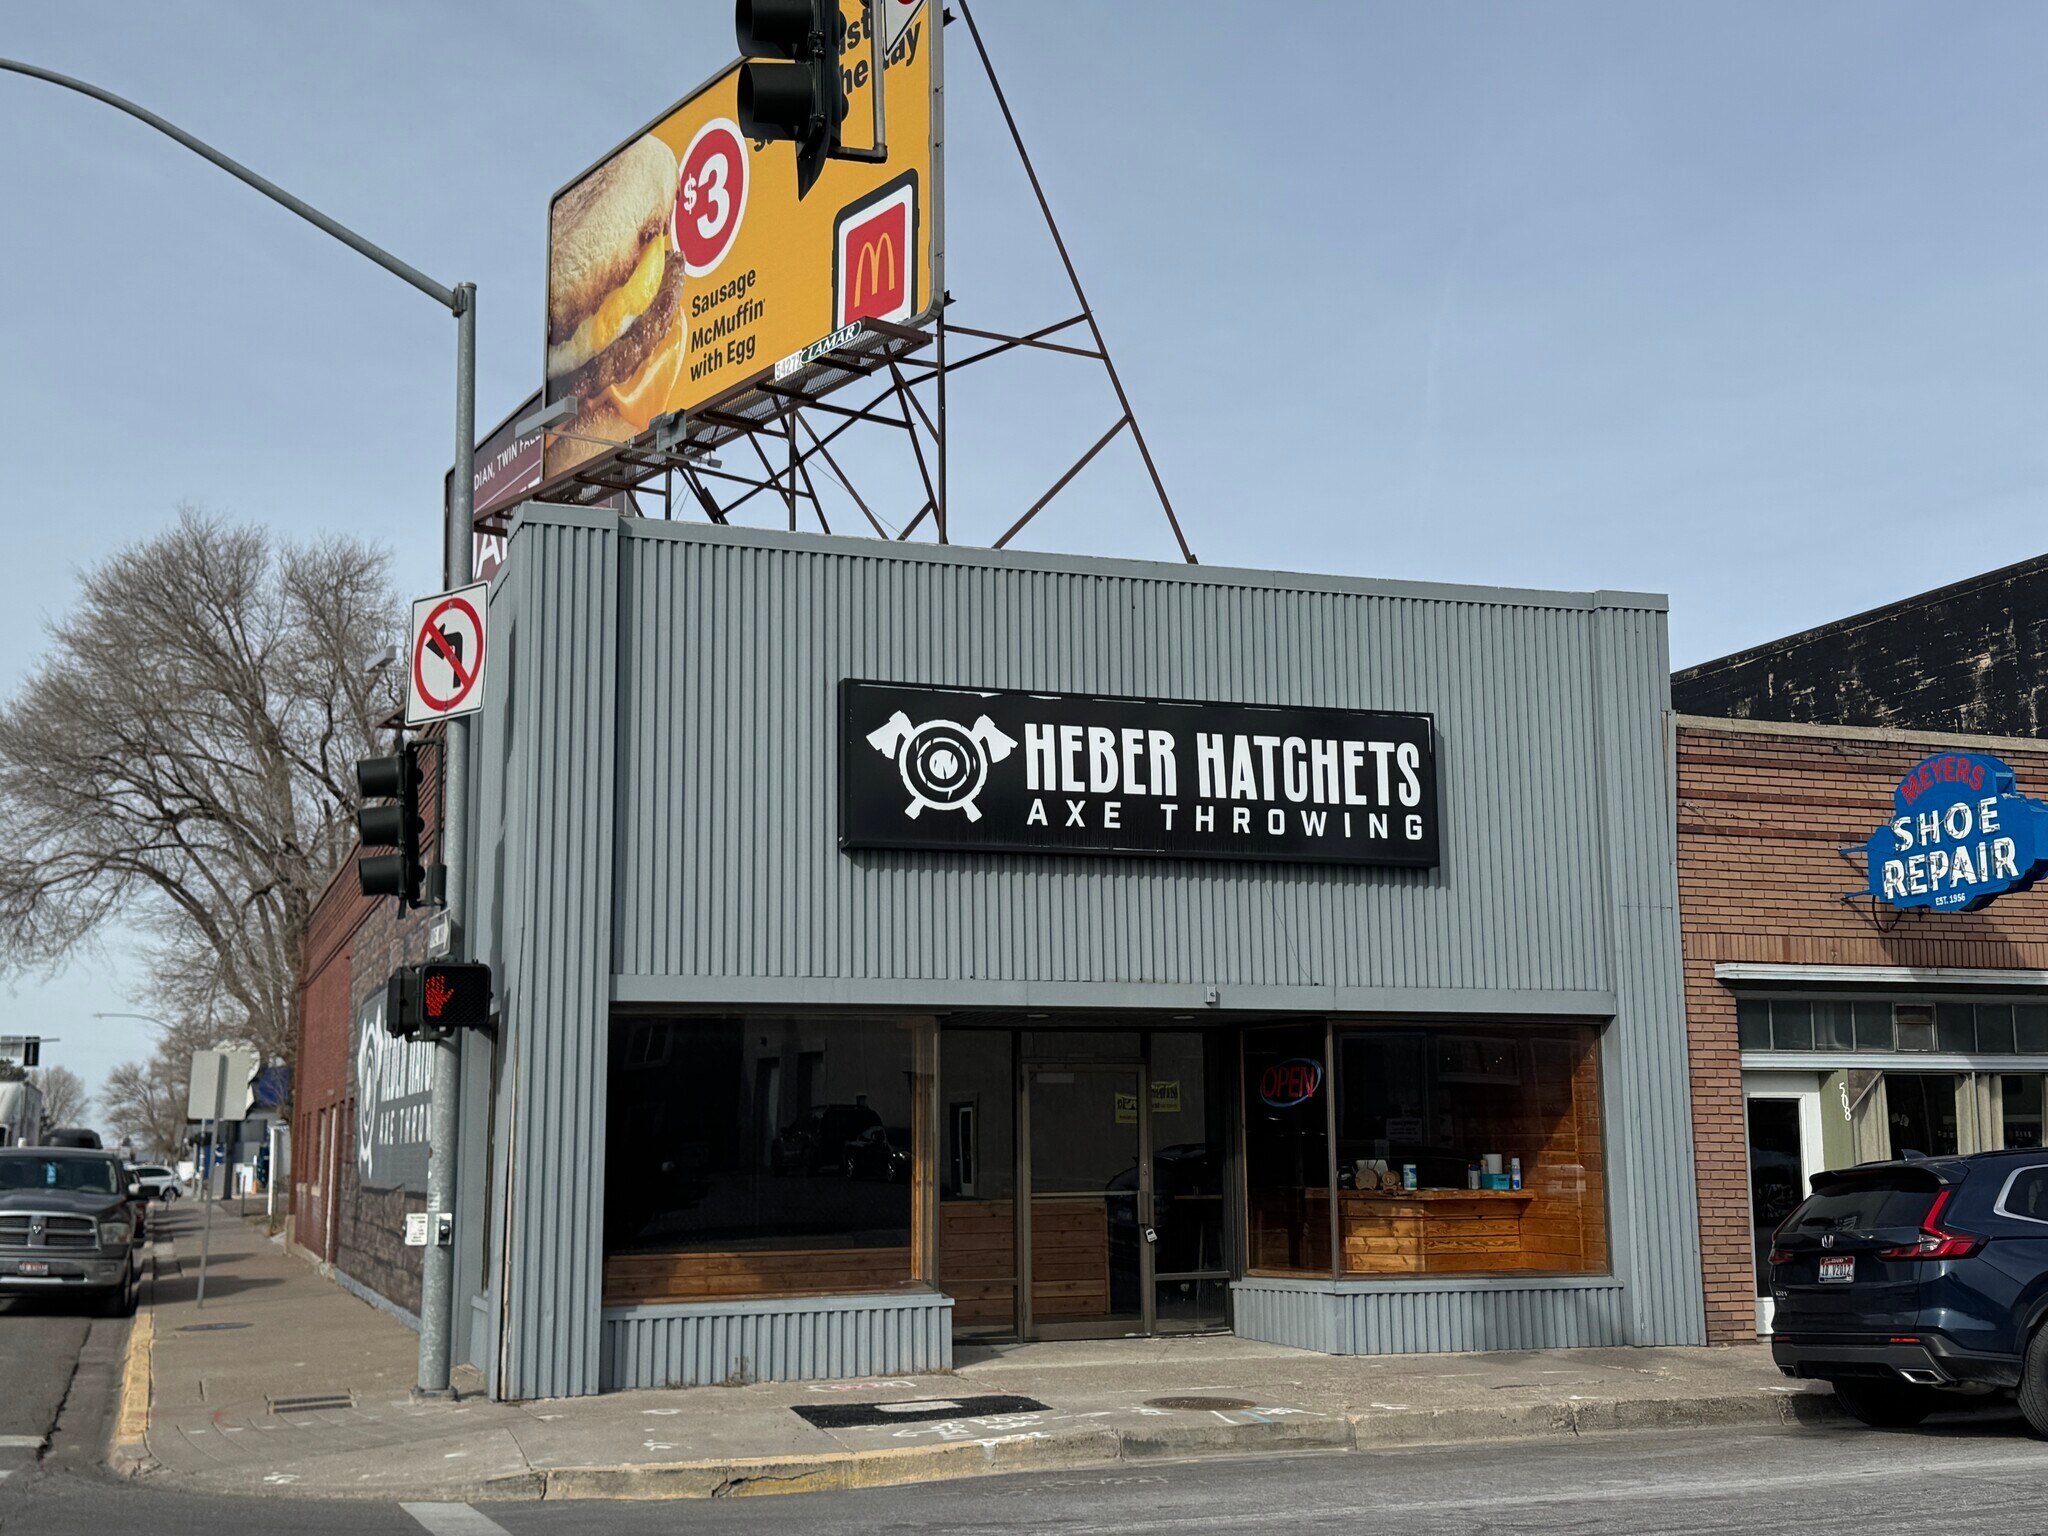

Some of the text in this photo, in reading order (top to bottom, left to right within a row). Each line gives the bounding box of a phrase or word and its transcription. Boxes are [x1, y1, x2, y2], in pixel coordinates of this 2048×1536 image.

[840, 60, 868, 95] he
[684, 153, 730, 239] $3
[692, 269, 756, 318] Sausage
[691, 298, 764, 353] McMuffin
[808, 325, 855, 361] LAMAR
[690, 334, 756, 382] with Egg
[497, 441, 518, 471] TWIN
[1025, 723, 1421, 807] HEBER HATCHETS
[1901, 757, 1985, 806] MEYERS
[1026, 798, 1423, 841] AXE THROWING
[1890, 796, 2000, 852] SHOE
[1882, 836, 2019, 899] REPAIR
[1935, 893, 1966, 906] EST. 1956
[1262, 1066, 1316, 1098] OPEN
[1839, 1082, 1852, 1121] 508
